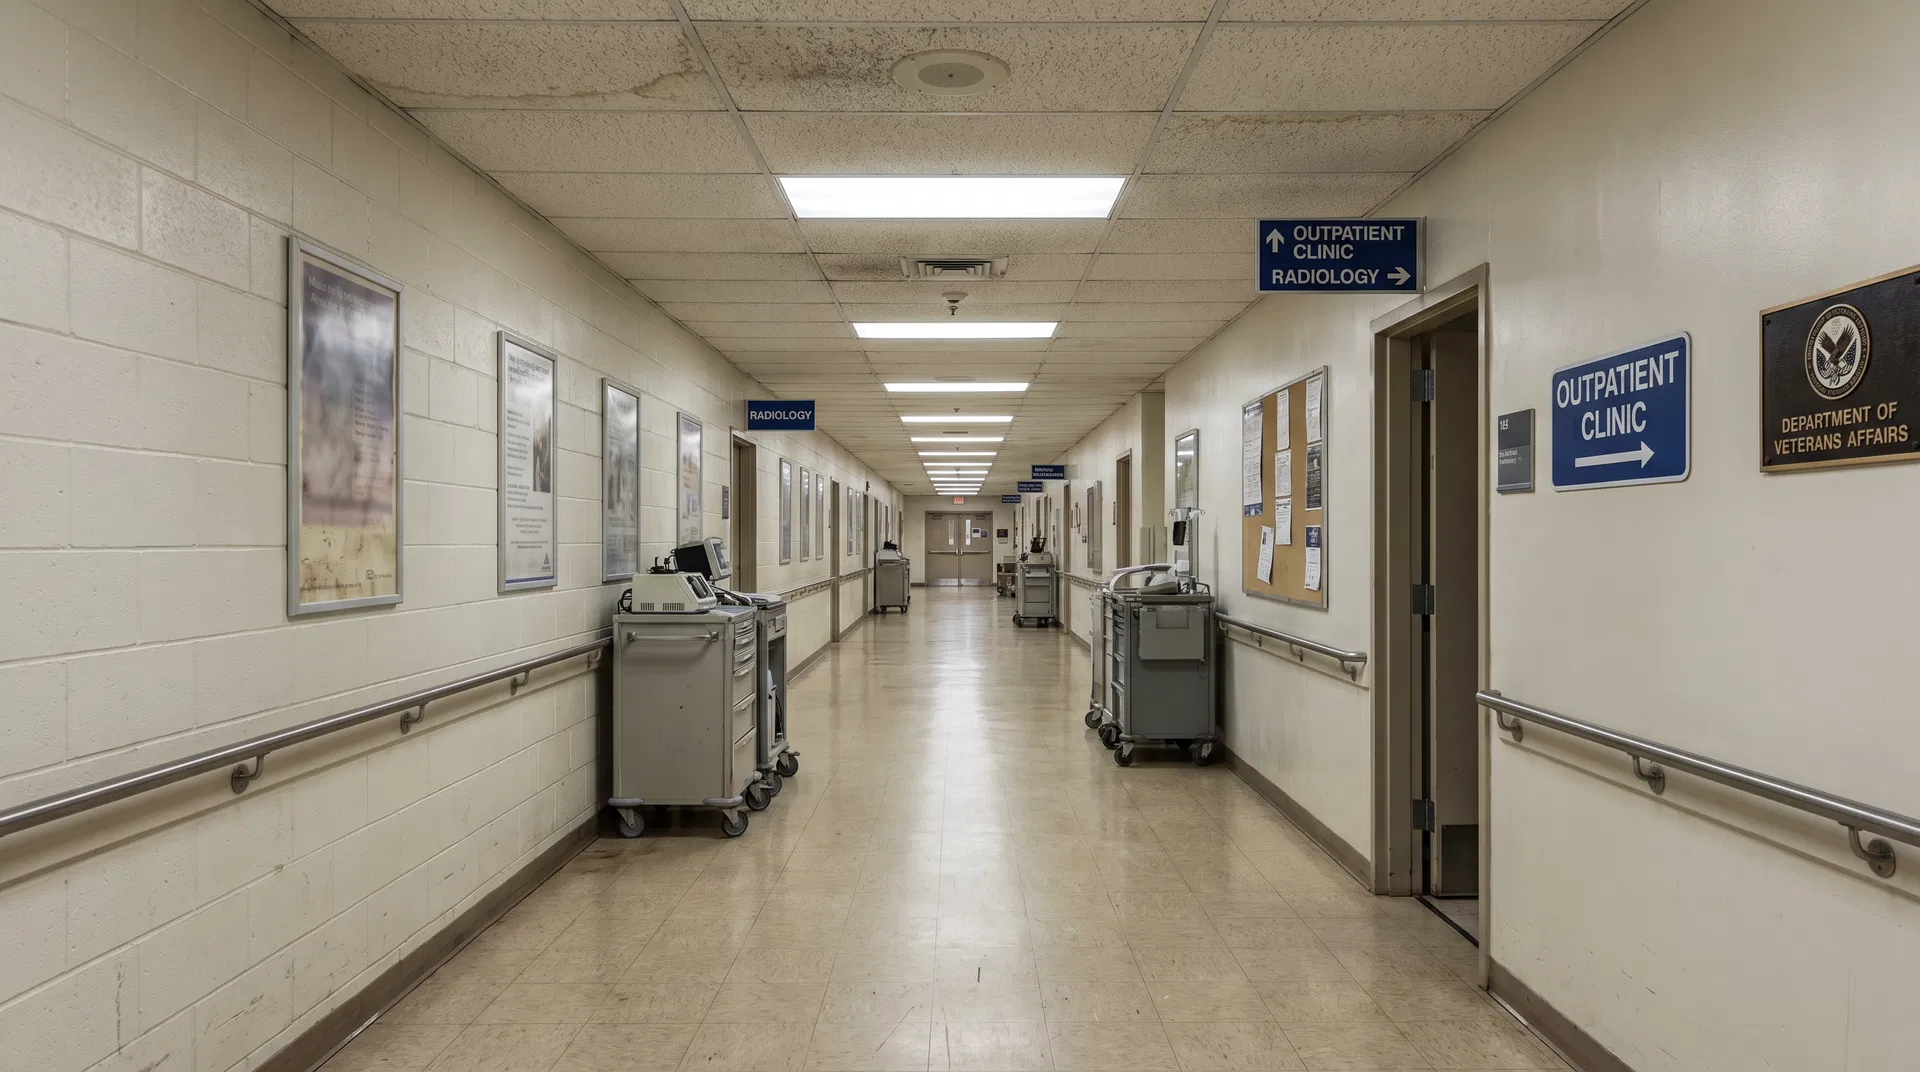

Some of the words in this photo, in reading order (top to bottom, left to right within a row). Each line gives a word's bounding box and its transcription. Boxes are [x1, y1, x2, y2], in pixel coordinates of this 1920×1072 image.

[1293, 225, 1405, 241] OUTPATIENT
[1293, 244, 1354, 260] CLINIC
[1272, 269, 1380, 285] RADIOLOGY
[1556, 351, 1680, 409] OUTPATIENT
[749, 410, 812, 420] RADIOLOGY
[1581, 401, 1647, 441] CLINIC
[1781, 405, 1872, 434] DEPARTMENT
[1876, 401, 1898, 421] OF
[1774, 432, 1842, 455] VETERANS
[1847, 424, 1909, 448] AFFAIRS
